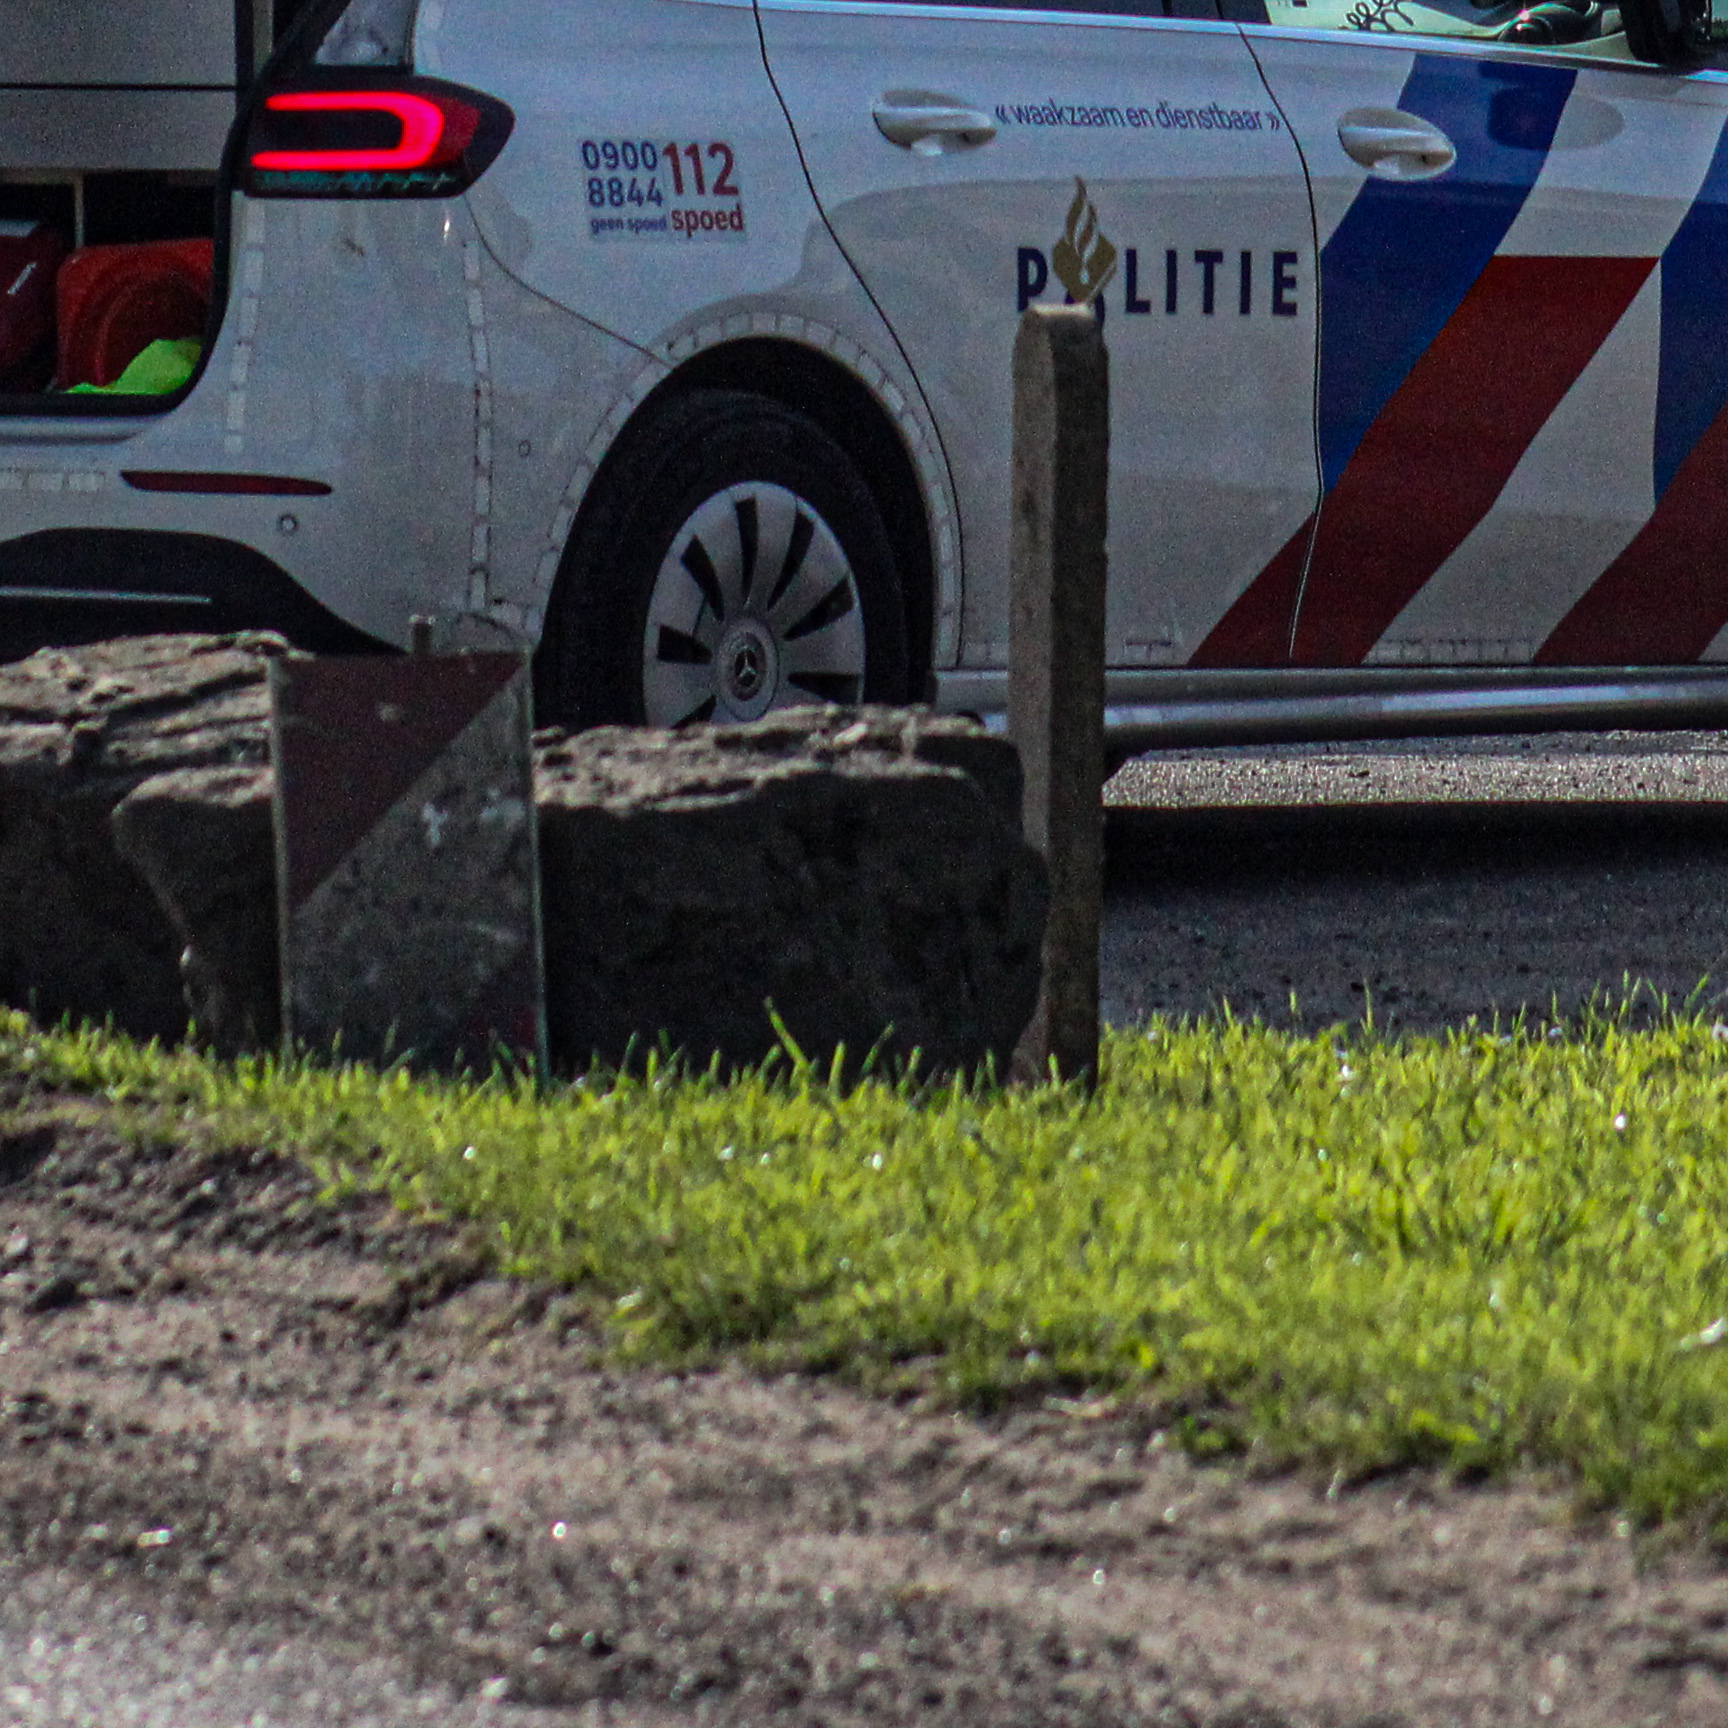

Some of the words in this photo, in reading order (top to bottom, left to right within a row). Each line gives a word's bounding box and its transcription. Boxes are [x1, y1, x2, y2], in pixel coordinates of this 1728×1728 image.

[1012, 98, 1125, 128] waakzaam
[1126, 107, 1155, 129] en
[1157, 101, 1263, 131] dienstbaar
[581, 139, 658, 171] 0900
[662, 141, 739, 196] 112
[587, 176, 664, 207] 8844
[671, 202, 745, 238] spoed
[1017, 246, 1298, 317] PLITIE
